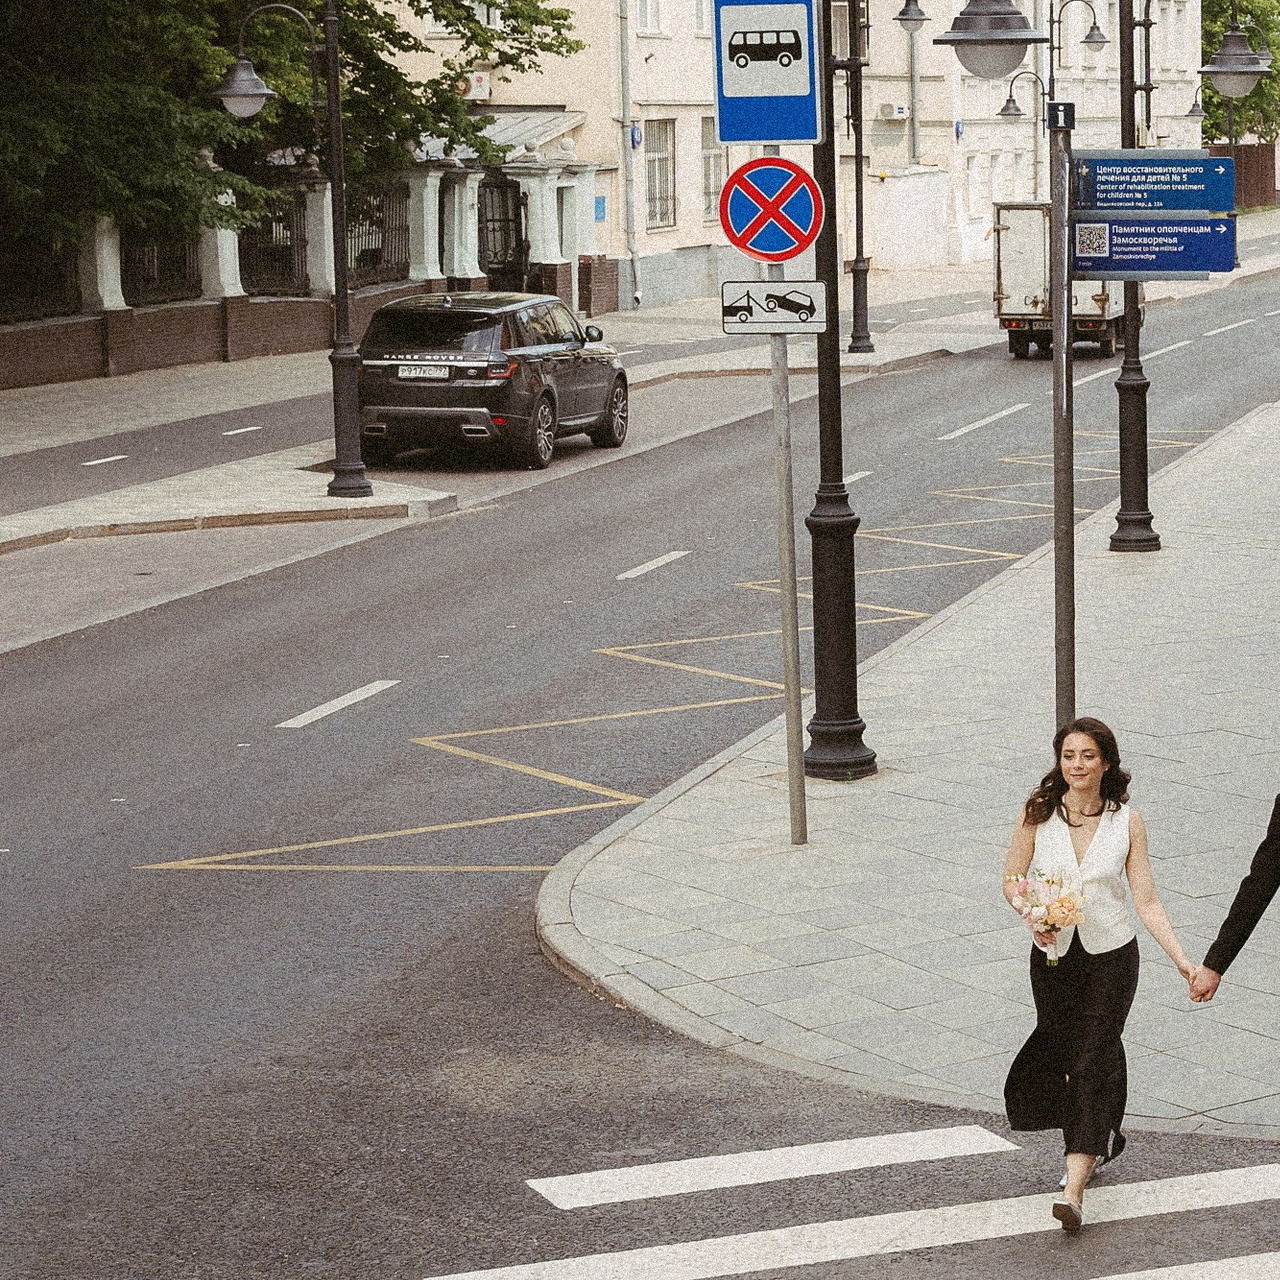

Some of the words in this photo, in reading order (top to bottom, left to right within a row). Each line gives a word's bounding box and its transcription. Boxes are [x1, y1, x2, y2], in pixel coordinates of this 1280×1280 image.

[1096, 165, 1122, 175] Центр
[1122, 166, 1204, 174] восстановительного
[1131, 175, 1146, 183] для
[1147, 174, 1170, 183] детей
[1171, 174, 1181, 182] №
[1182, 174, 1188, 182] 5
[1111, 225, 1156, 233] Памятник
[1156, 226, 1212, 234] ополченцам
[1111, 236, 1178, 245] Замоскворечья
